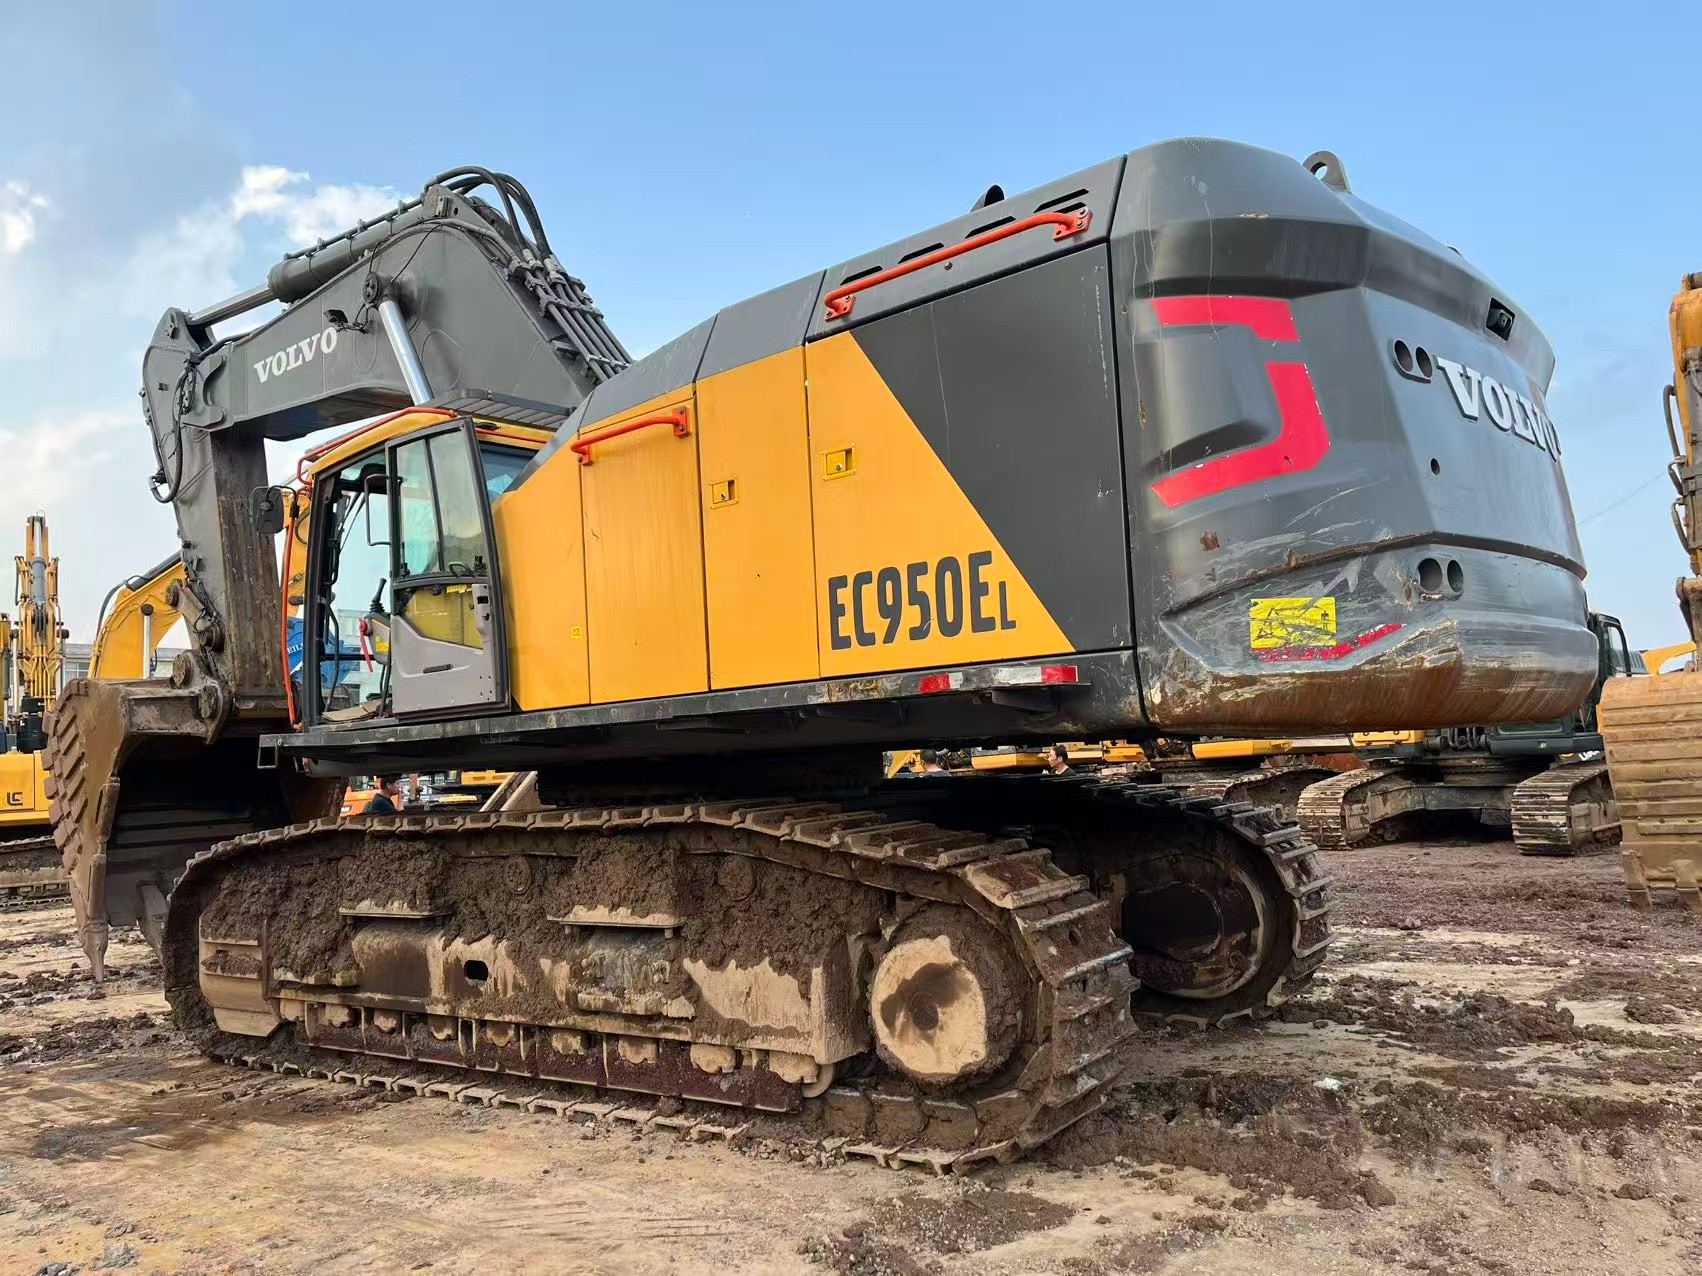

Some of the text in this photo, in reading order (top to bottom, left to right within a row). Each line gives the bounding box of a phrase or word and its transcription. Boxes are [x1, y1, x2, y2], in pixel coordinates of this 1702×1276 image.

[253, 326, 338, 384] VOLVO
[1436, 355, 1562, 463] VOLVO
[828, 550, 1017, 650] EC950EL
